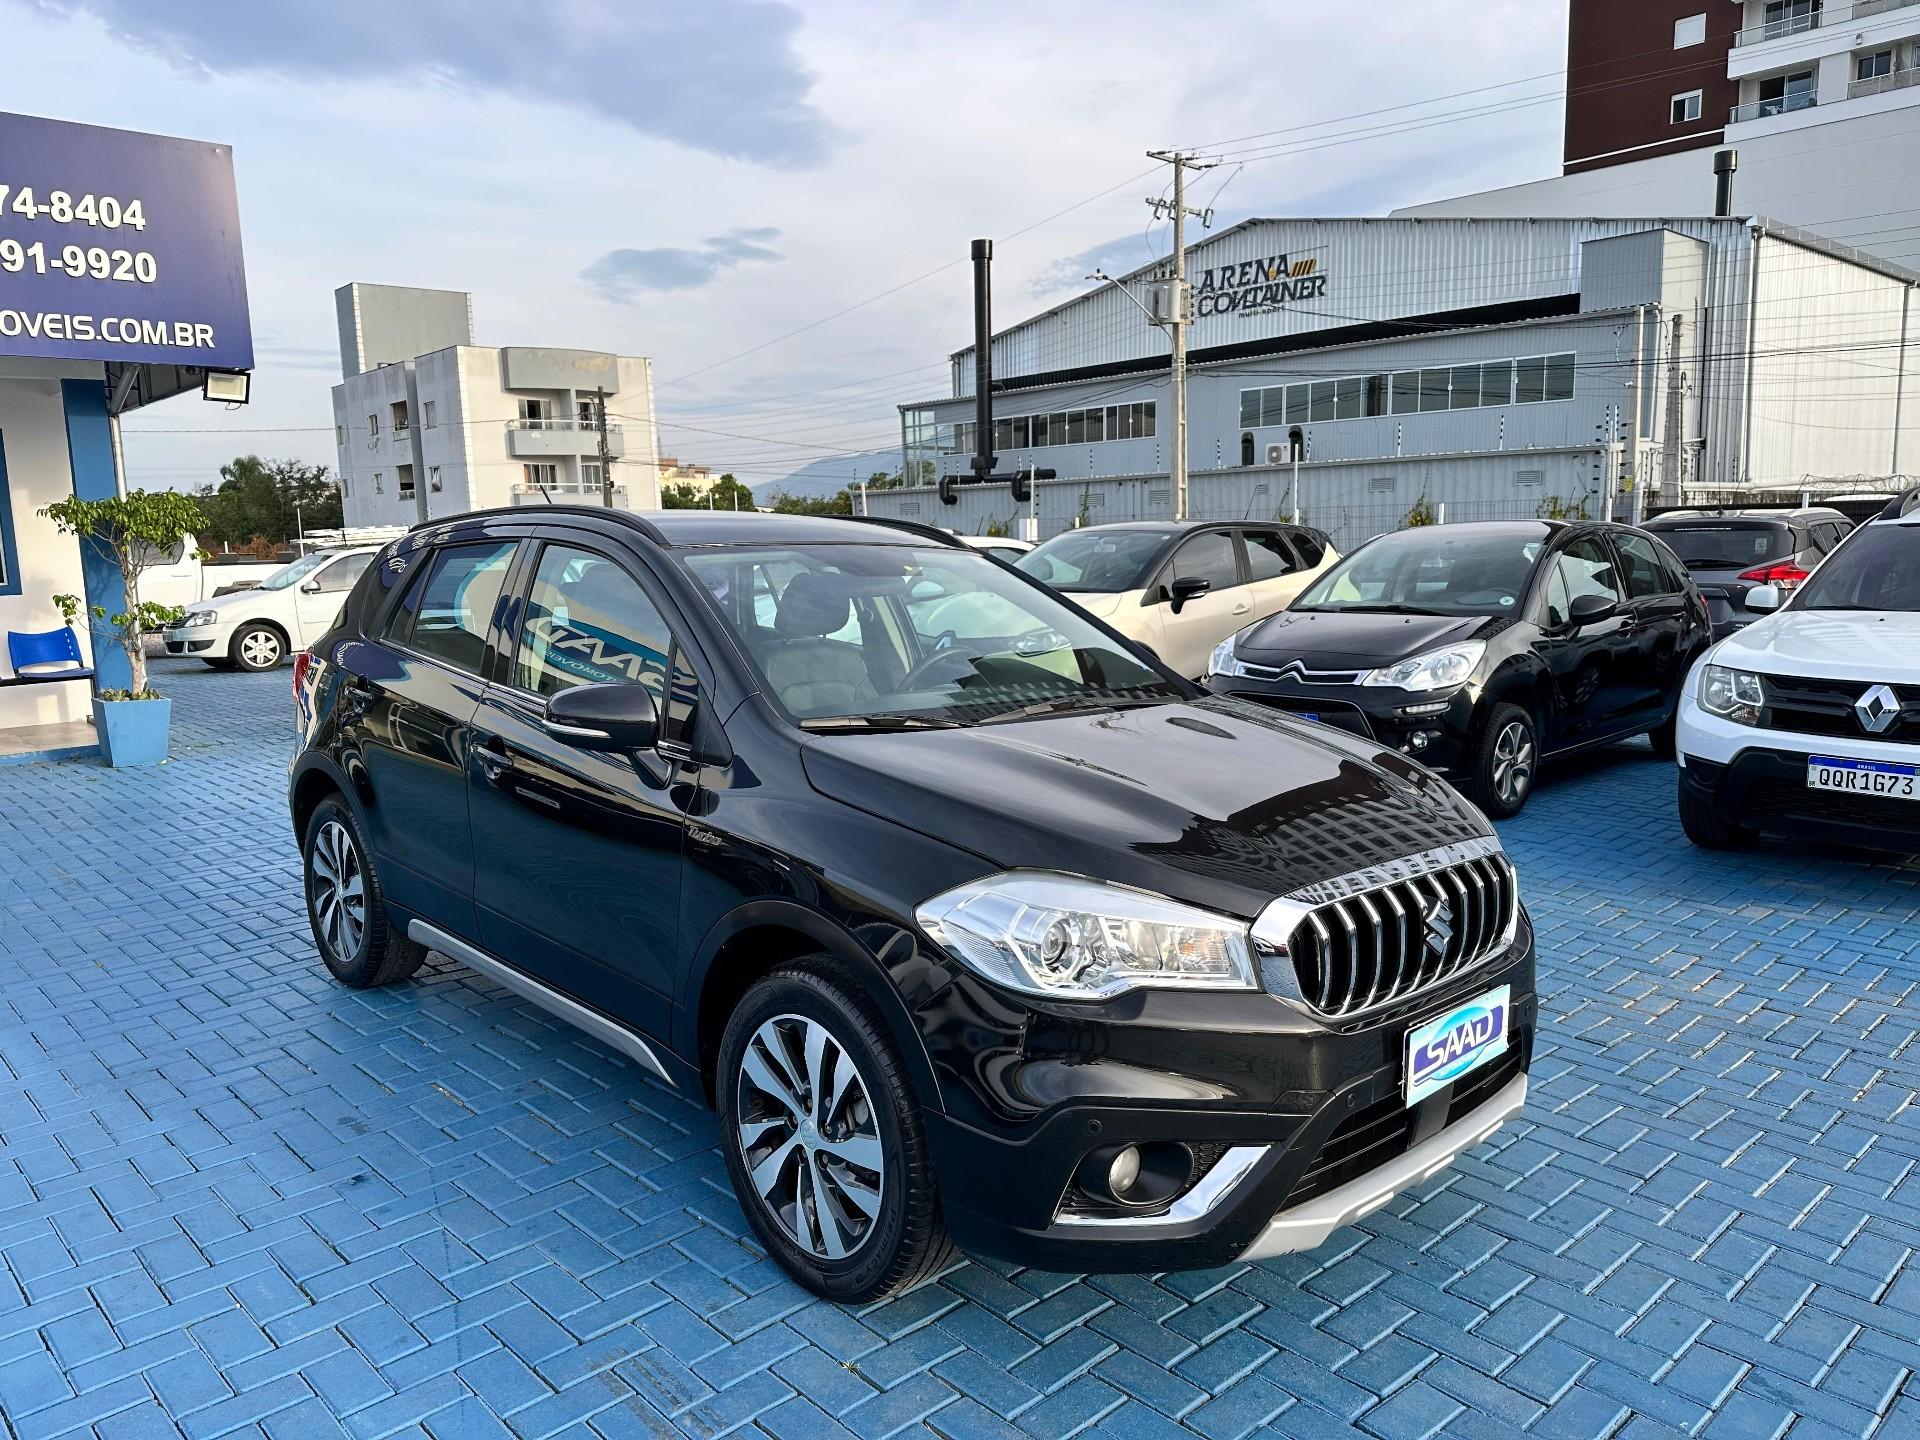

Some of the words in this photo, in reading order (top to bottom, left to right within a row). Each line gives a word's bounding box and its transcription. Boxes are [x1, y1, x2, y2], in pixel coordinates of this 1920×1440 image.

[0, 239, 157, 283] 91-9920
[1198, 254, 1291, 294] ARENA
[1198, 275, 1327, 317] CONTAINER
[0, 310, 215, 348] OVEIS.COM.BR
[1819, 768, 1914, 796] QQR1G73
[1423, 1010, 1494, 1070] SAAD
